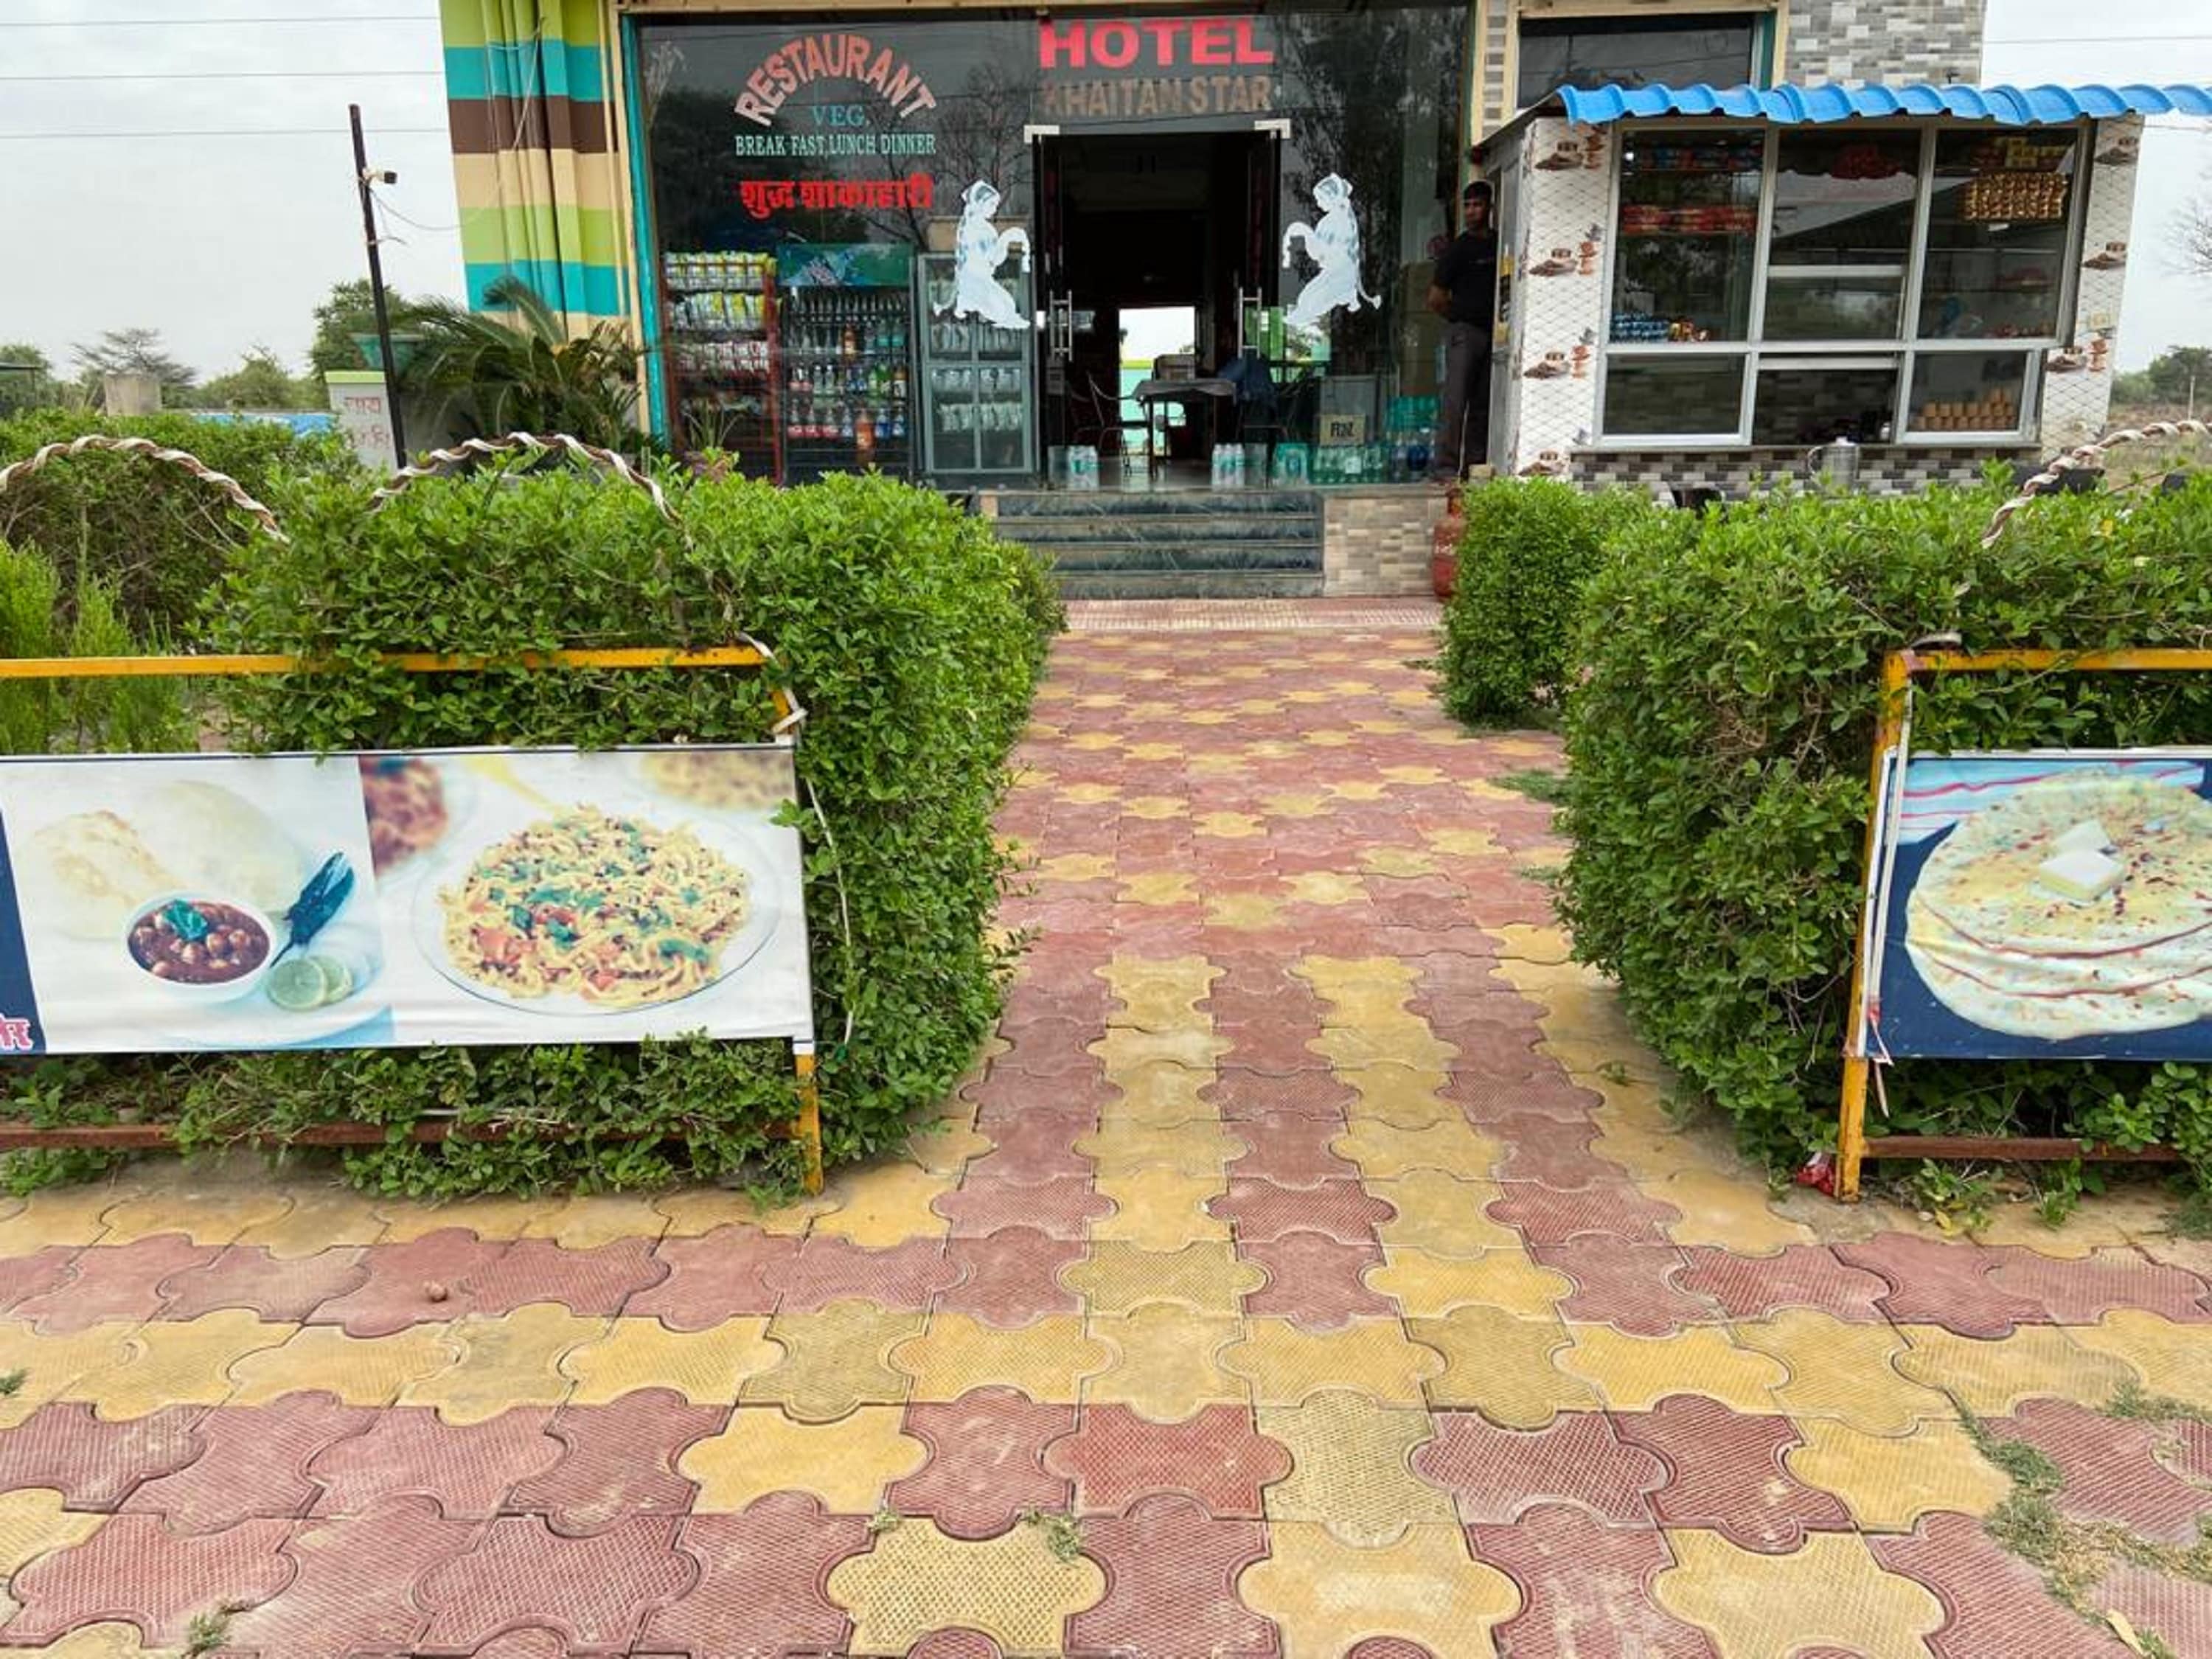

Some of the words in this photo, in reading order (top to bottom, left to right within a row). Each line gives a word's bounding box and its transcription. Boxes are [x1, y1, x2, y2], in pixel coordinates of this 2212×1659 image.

[1039, 18, 1273, 69] HOTEL
[734, 34, 936, 126] RESTAURANT
[1189, 75, 1273, 113] STAR
[880, 133, 936, 156] DINNER
[740, 180, 796, 220] शुद्ध
